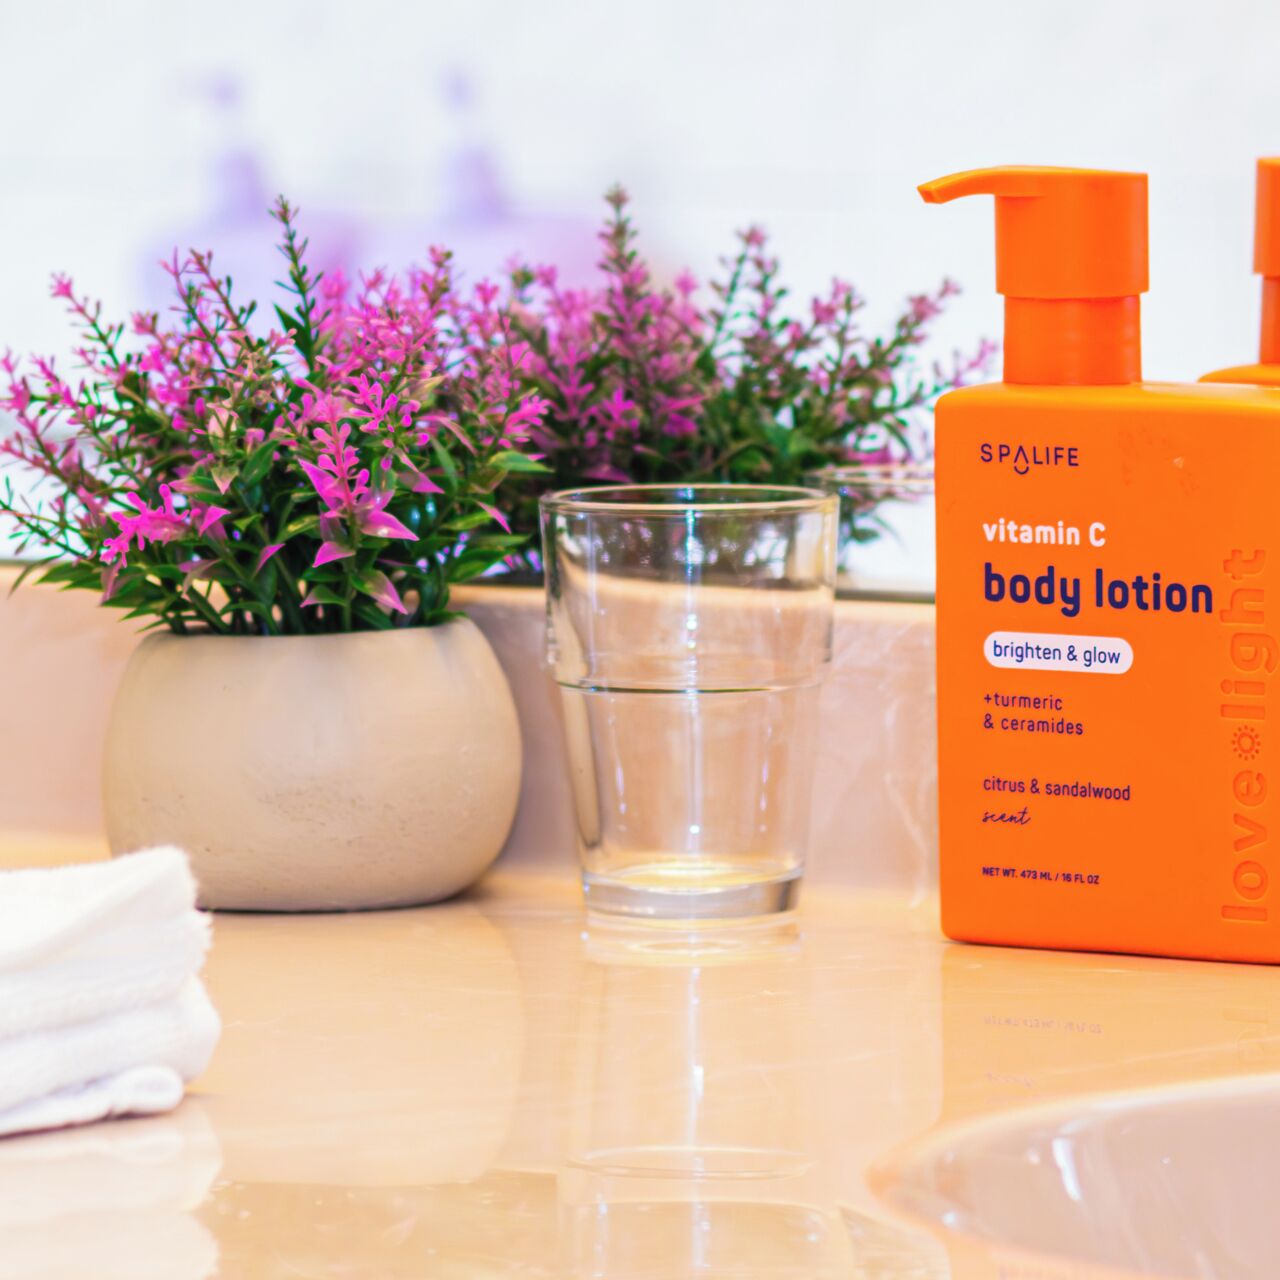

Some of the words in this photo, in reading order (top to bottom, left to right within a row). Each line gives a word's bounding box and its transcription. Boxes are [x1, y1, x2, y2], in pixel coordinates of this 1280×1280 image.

[982, 517, 1081, 546] vitamin
[1088, 521, 1107, 548] C
[984, 561, 1081, 618] body
[1095, 567, 1213, 614] lotion
[1220, 549, 1280, 721] light
[993, 639, 1062, 663] brighten
[1066, 644, 1078, 662] &
[1083, 646, 1121, 667] glow
[983, 692, 1064, 711] +turmeric
[983, 713, 995, 729] &
[1001, 717, 1084, 736] ceramides
[983, 775, 1026, 793] citrus
[1029, 777, 1041, 794] &
[1045, 780, 1131, 801] sandalwood
[981, 806, 1032, 825] scent
[1221, 769, 1269, 923] love
[981, 866, 1000, 877] NET
[1002, 867, 1018, 879] WT.
[1020, 869, 1038, 880] 473
[1039, 871, 1053, 882] ML
[1074, 873, 1085, 884] FL
[1086, 874, 1100, 885] OZ
